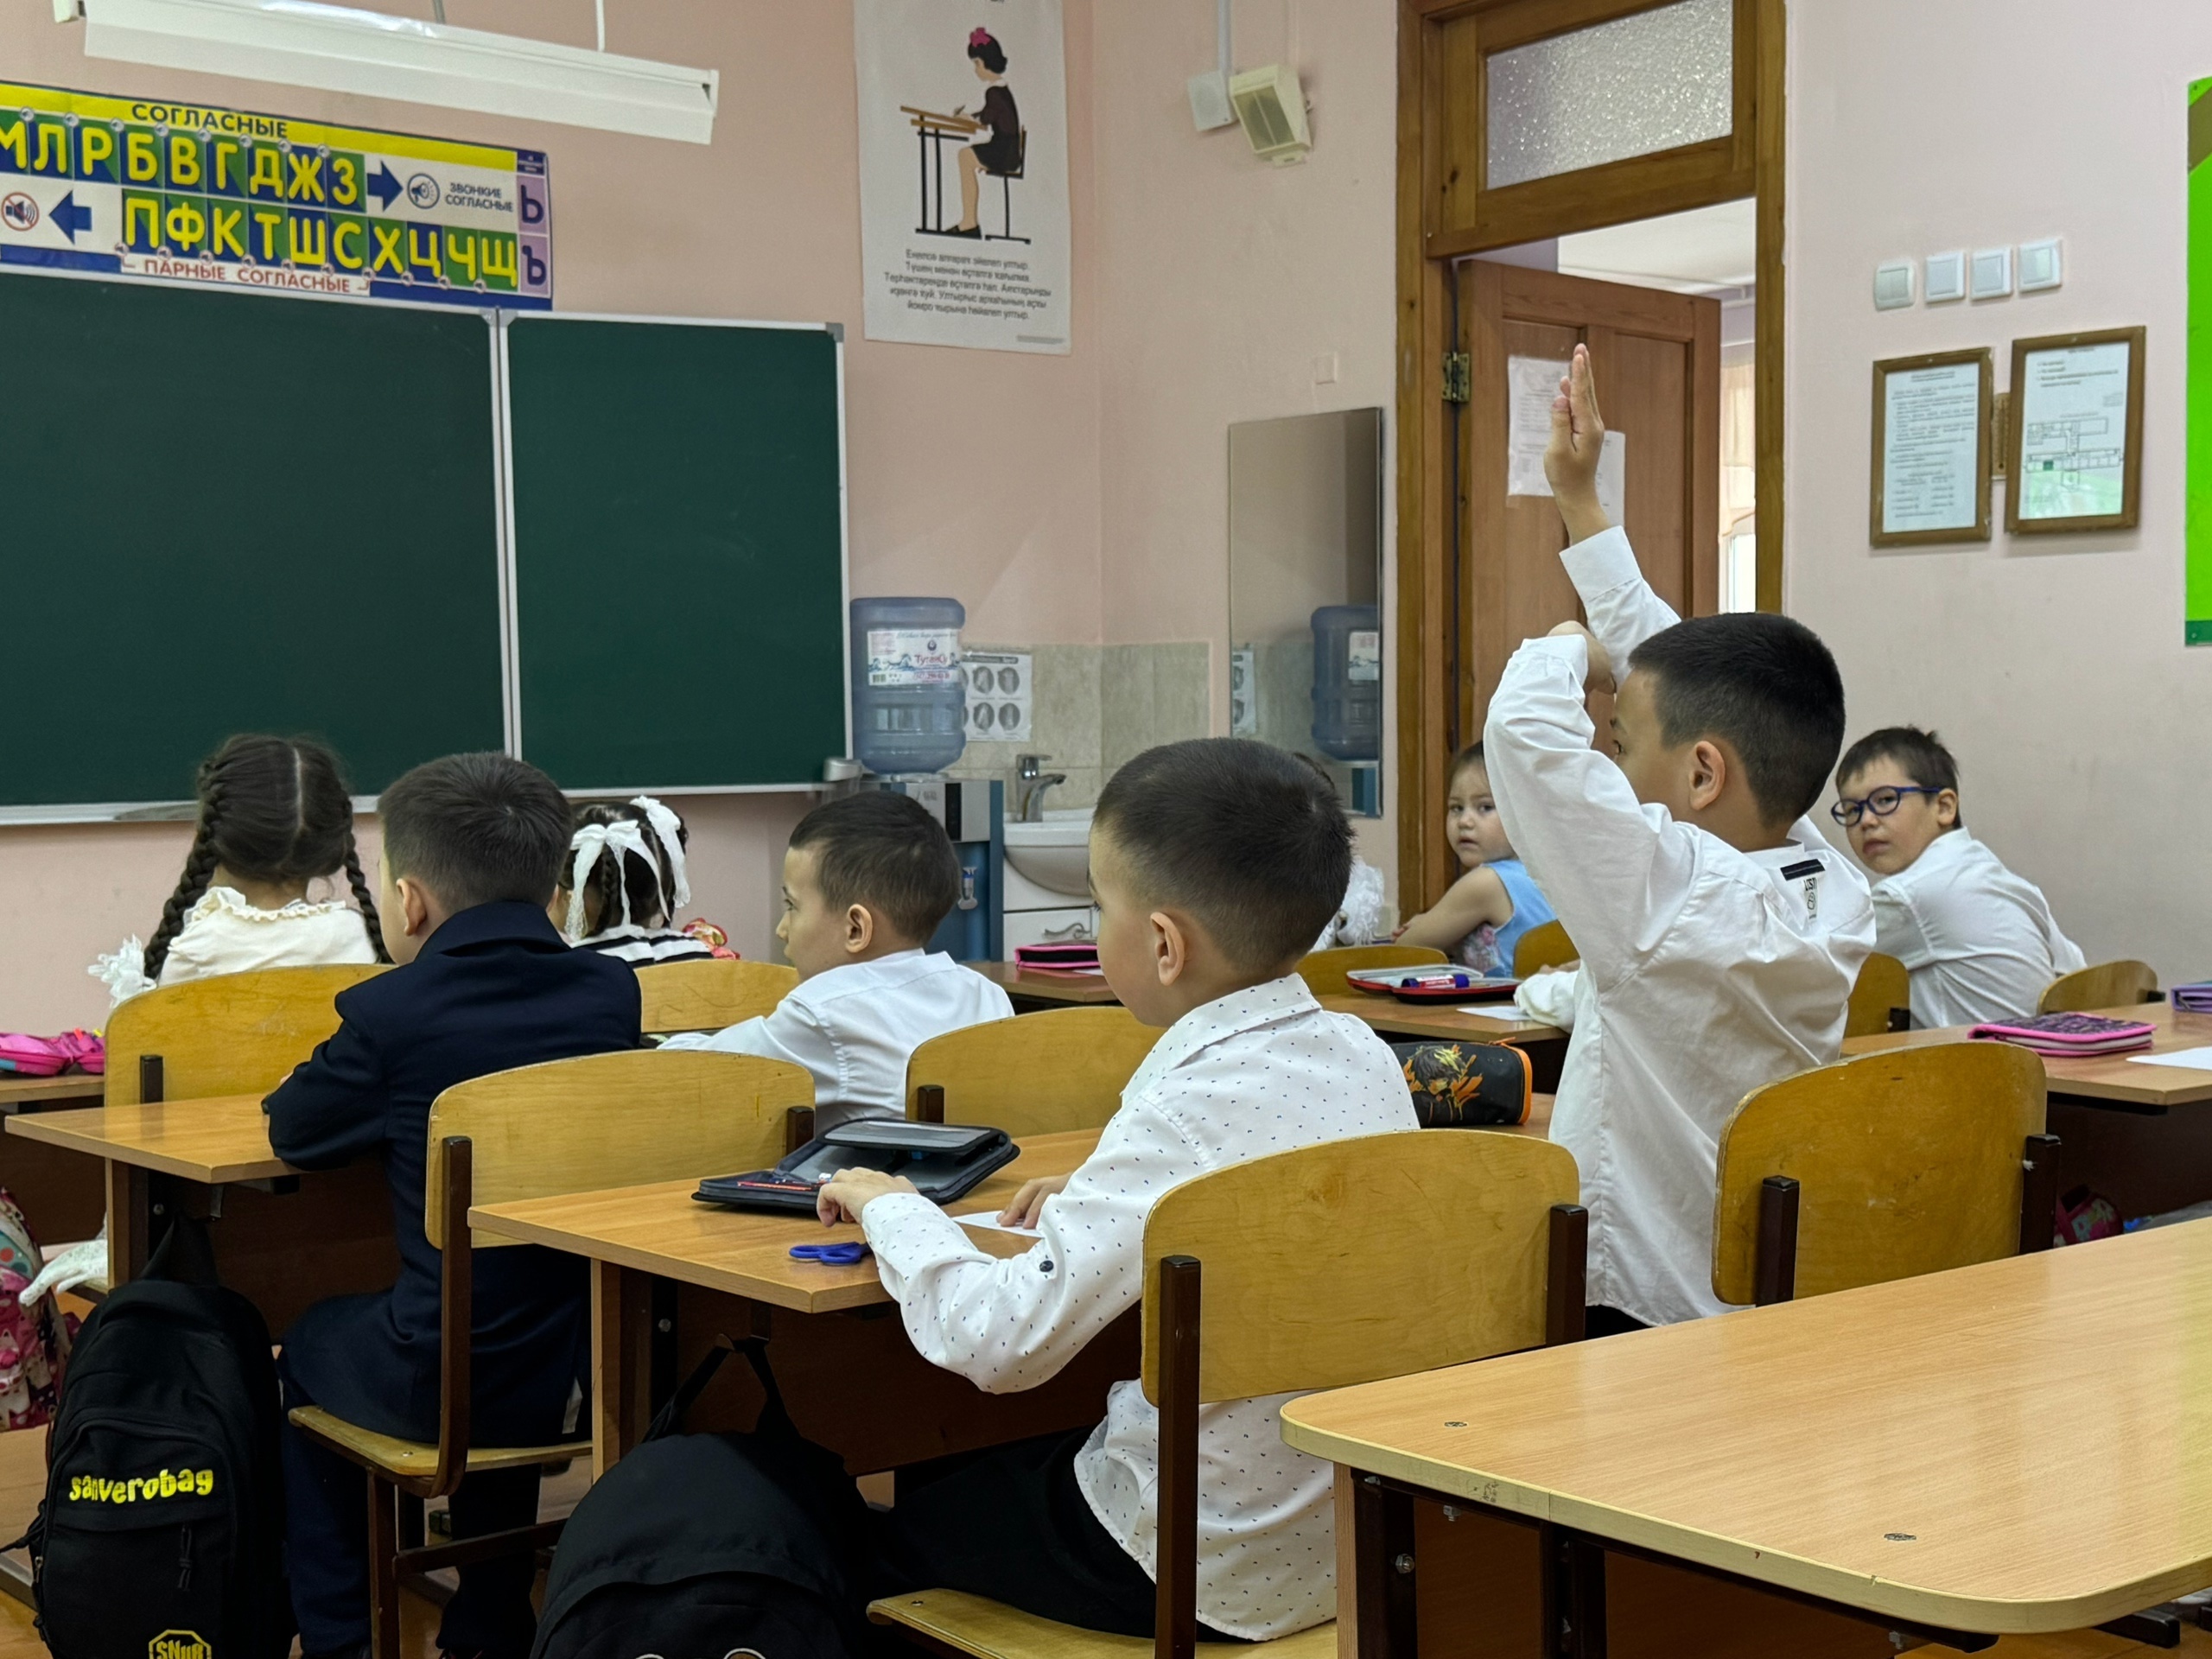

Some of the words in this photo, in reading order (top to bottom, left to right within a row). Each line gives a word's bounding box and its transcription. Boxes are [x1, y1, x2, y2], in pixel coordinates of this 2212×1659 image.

[131, 104, 288, 138] СОГЛАСНЫЕ
[34, 123, 67, 172] Л
[81, 127, 113, 175] Р
[127, 132, 158, 181] Б
[171, 137, 200, 185] В
[216, 142, 238, 189] Г
[250, 149, 283, 198] Д
[288, 154, 325, 202] Ж
[333, 158, 357, 205] З
[445, 194, 513, 212] СОГЛАСНЫЕ
[449, 182, 502, 199] ЗВОНКИЕ
[126, 197, 159, 248] П
[166, 201, 206, 251] Ф
[213, 207, 245, 257] К
[254, 213, 281, 260] Т
[289, 217, 327, 266] Ш
[333, 221, 363, 269] С
[372, 226, 404, 274] Х
[409, 229, 442, 278] Ц
[448, 233, 475, 282] Ч
[481, 238, 518, 288] Щ
[144, 259, 226, 281] ПАРНЫЕ
[238, 267, 350, 293] СОГЛАСНЫЕ
